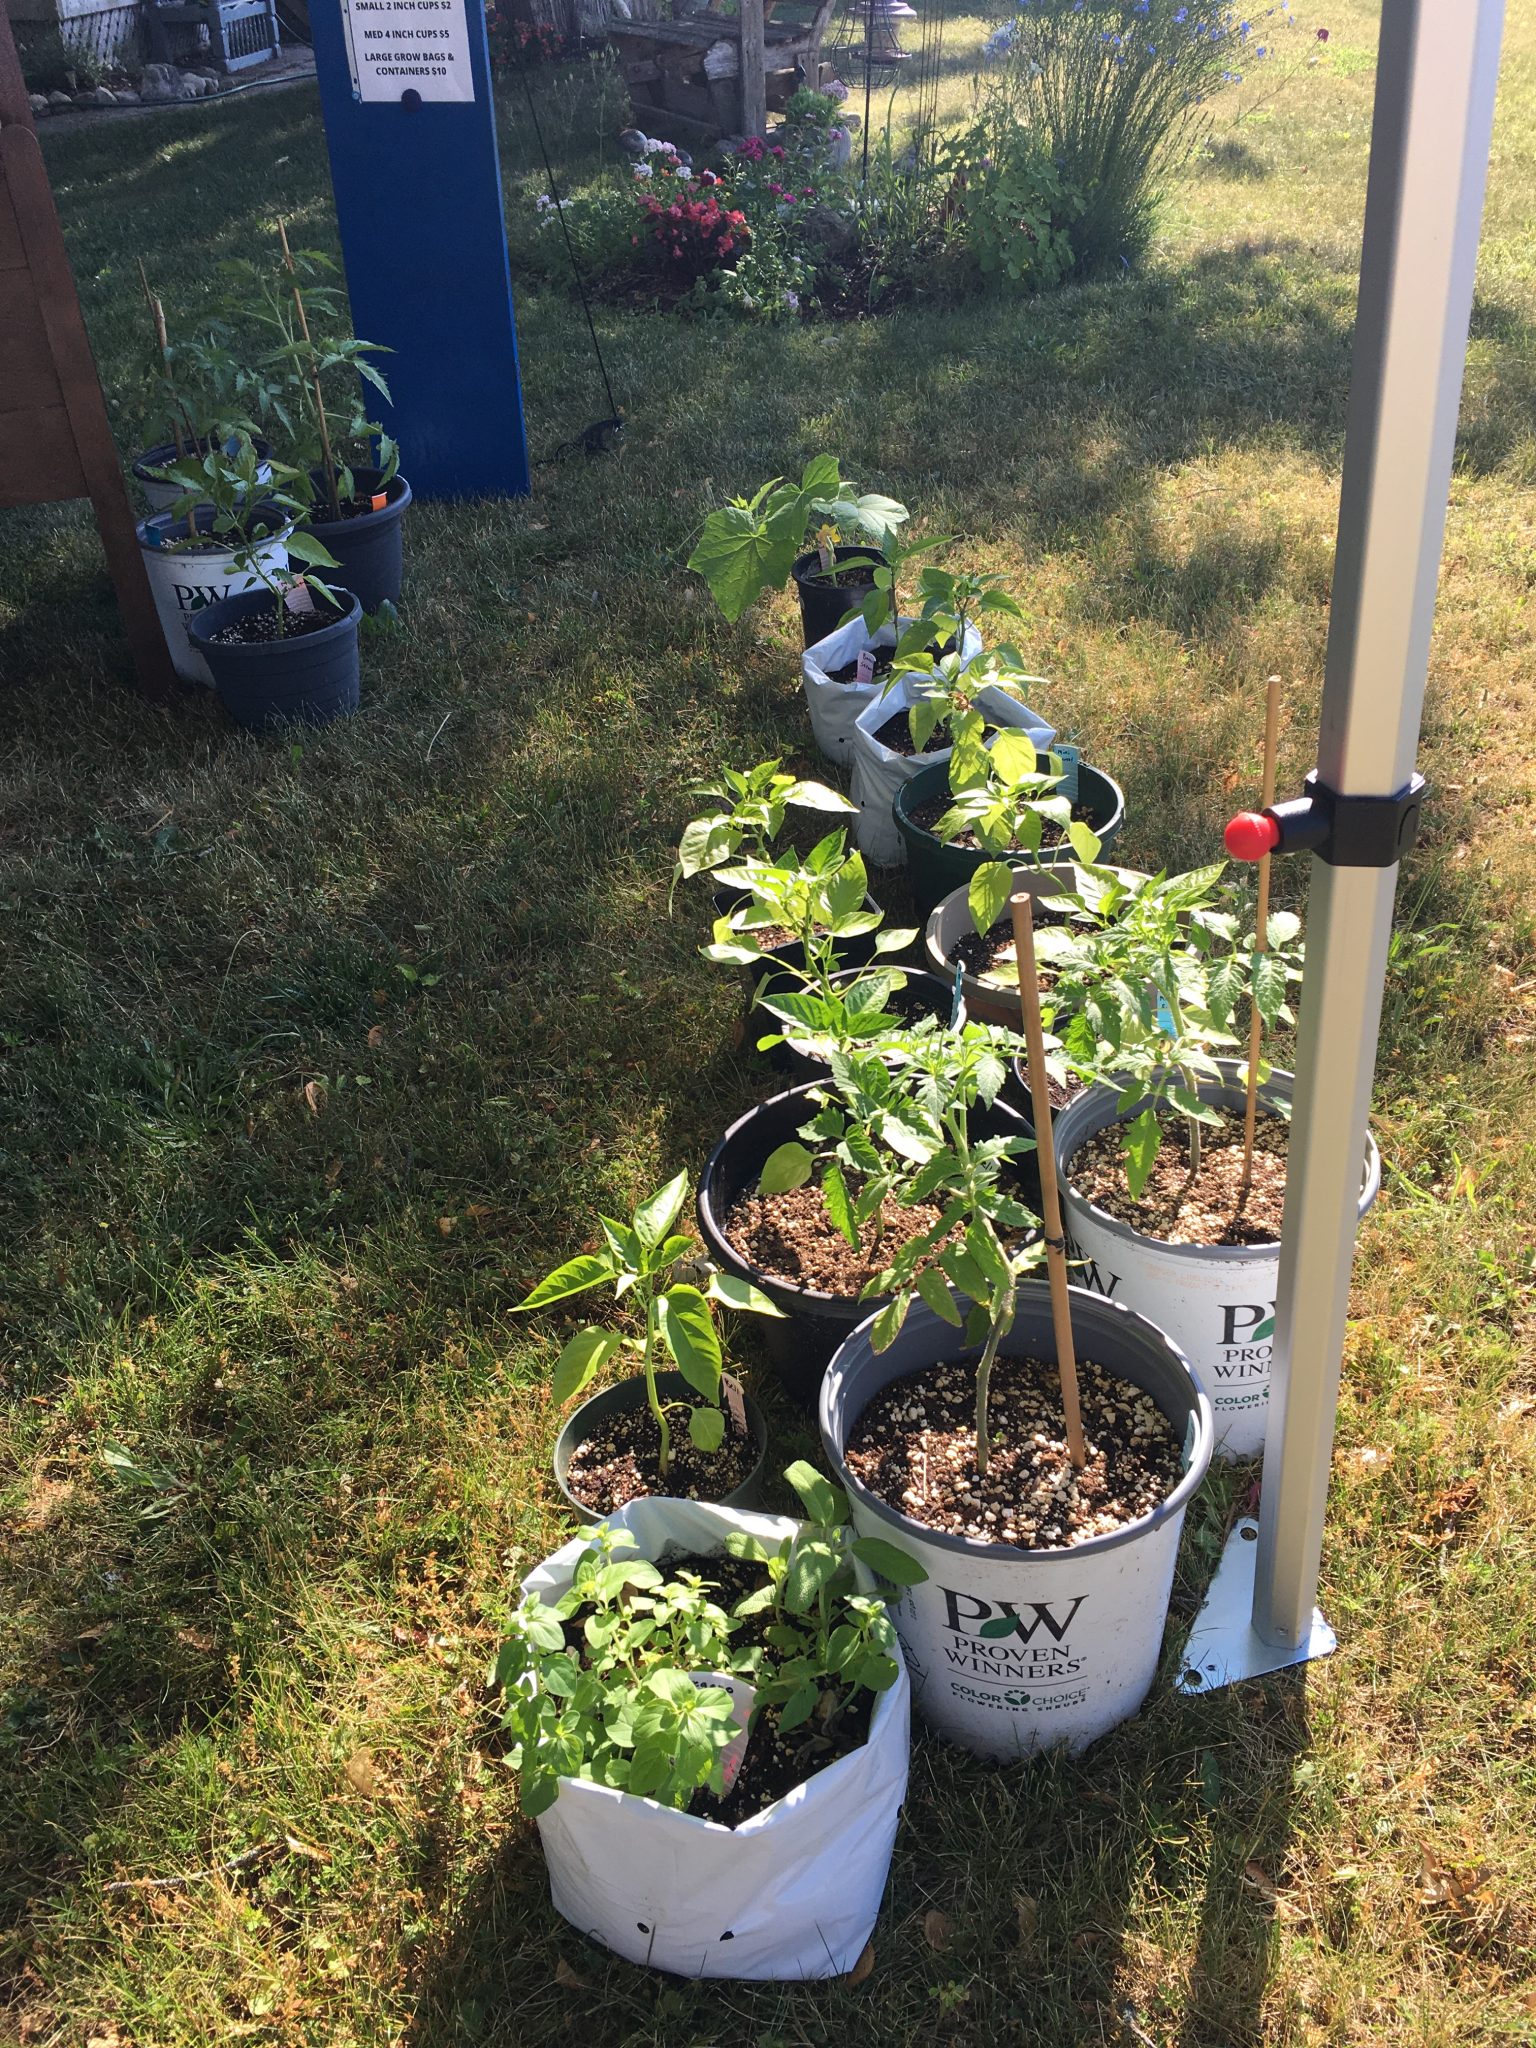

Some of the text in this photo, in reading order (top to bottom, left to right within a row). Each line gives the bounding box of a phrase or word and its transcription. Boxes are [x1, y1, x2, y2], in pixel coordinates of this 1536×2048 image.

[355, 1, 452, 11] SMALL 2 INCH CUPS $2
[364, 29, 450, 39] MED 4 INCH CUPS $5
[364, 52, 455, 62] LARGE GROW BAGS &
[375, 66, 447, 76] CONTAINERS $10
[172, 584, 232, 610] PW
[1216, 1300, 1276, 1345] P
[1223, 1345, 1273, 1362] PRO
[1214, 1394, 1260, 1405] COLOR
[936, 1585, 1090, 1645] PW
[952, 1635, 1072, 1662] PROVEN
[950, 1682, 1002, 1704] COLOR
[952, 1691, 1029, 1713] FLOWERING
